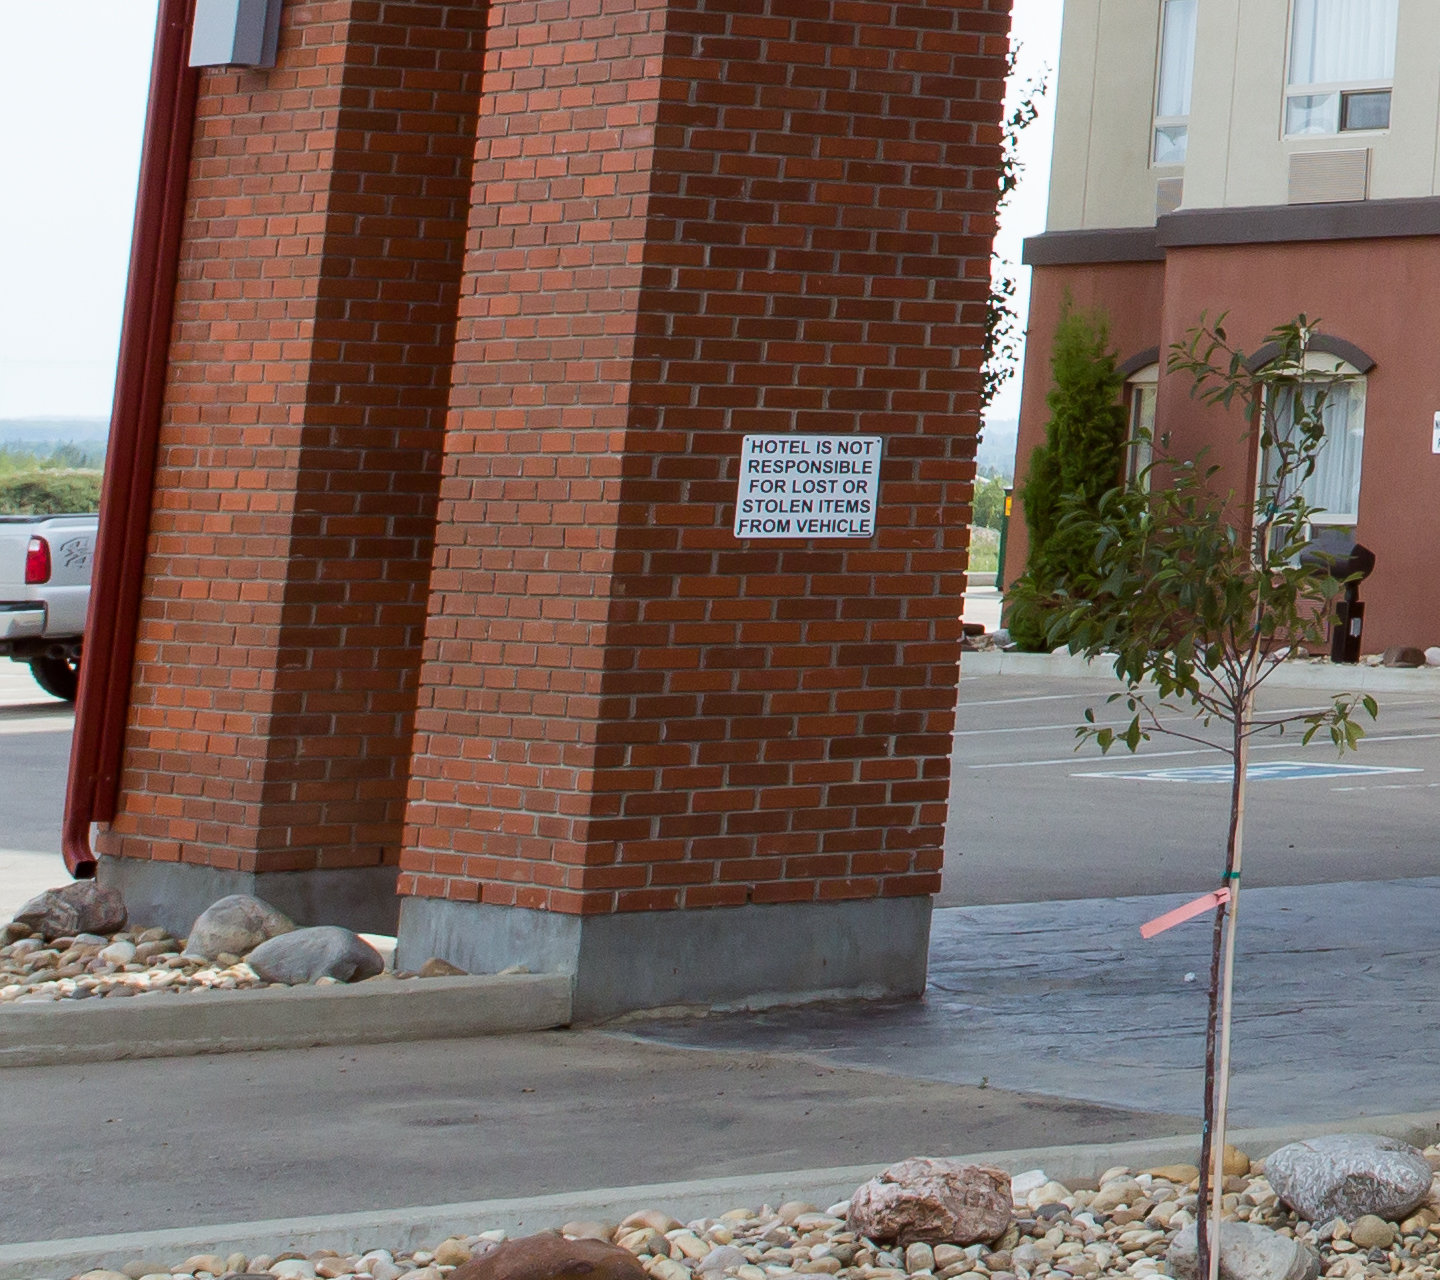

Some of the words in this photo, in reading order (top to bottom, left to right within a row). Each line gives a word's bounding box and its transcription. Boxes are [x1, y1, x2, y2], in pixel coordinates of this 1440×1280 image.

[751, 440, 811, 455] HOTEL
[816, 440, 832, 455] IS
[837, 441, 874, 455] NOT
[748, 459, 873, 475] RESPONSIBLE
[749, 479, 786, 494] FOR
[792, 479, 838, 494] LOST
[842, 479, 868, 494] OR
[742, 499, 814, 514] STOLEN
[818, 499, 871, 514] ITEMS
[738, 519, 791, 533] FROM
[796, 519, 871, 533] VEHICLE
